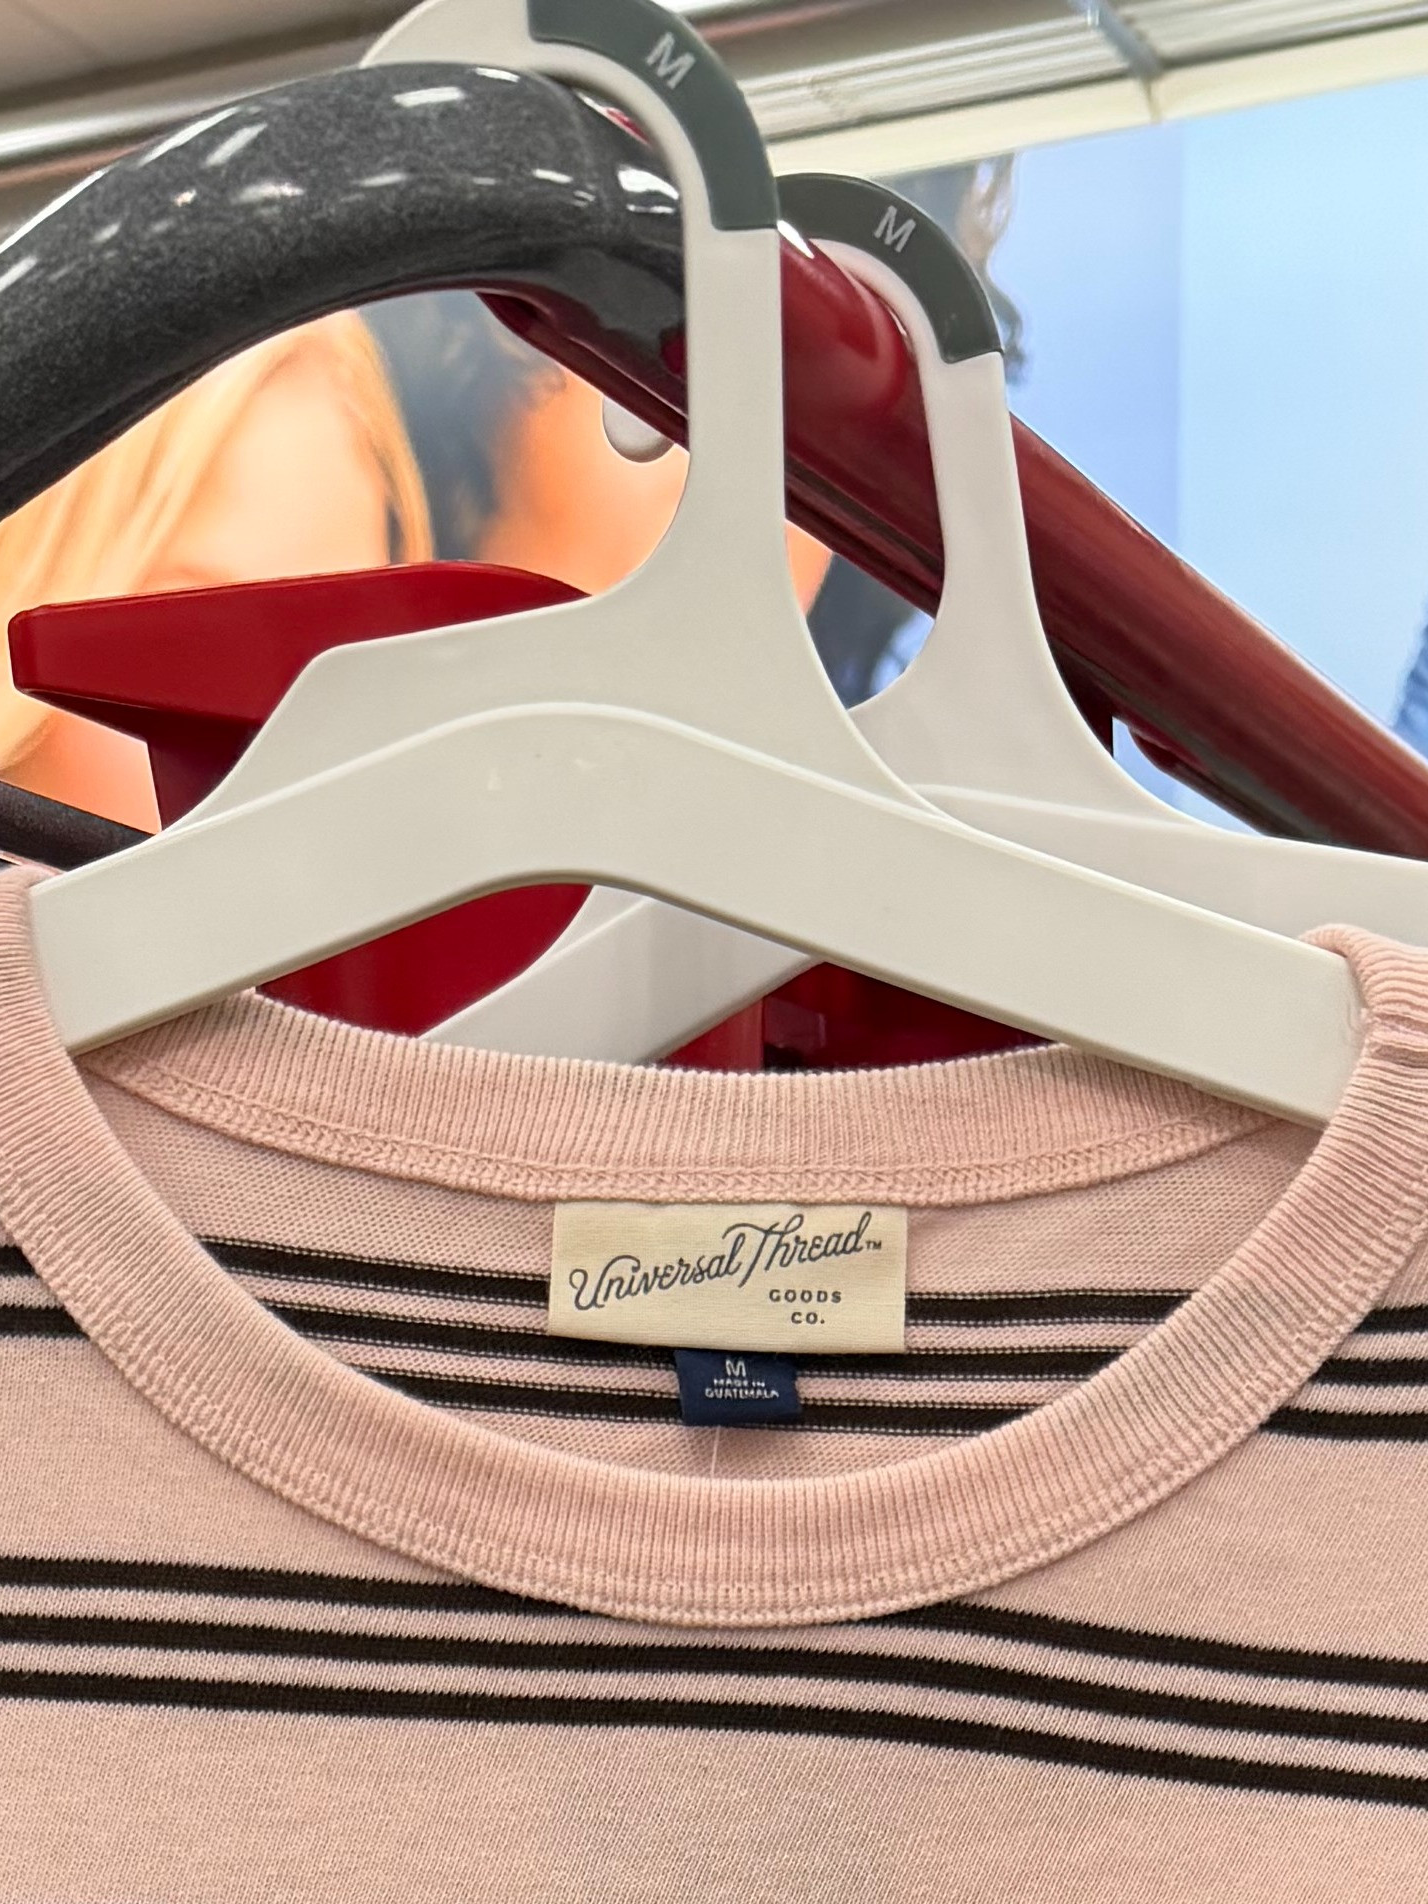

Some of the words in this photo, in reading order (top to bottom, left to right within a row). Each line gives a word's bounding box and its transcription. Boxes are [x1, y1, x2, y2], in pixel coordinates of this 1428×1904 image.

[645, 32, 696, 89] M
[874, 205, 916, 253] M
[569, 1232, 745, 1310] Universal
[768, 1288, 842, 1304] GOODS
[790, 1310, 826, 1325] CO.
[725, 1359, 746, 1377] M
[714, 1378, 748, 1387] MADE
[704, 1387, 780, 1399] GUATEMALA
